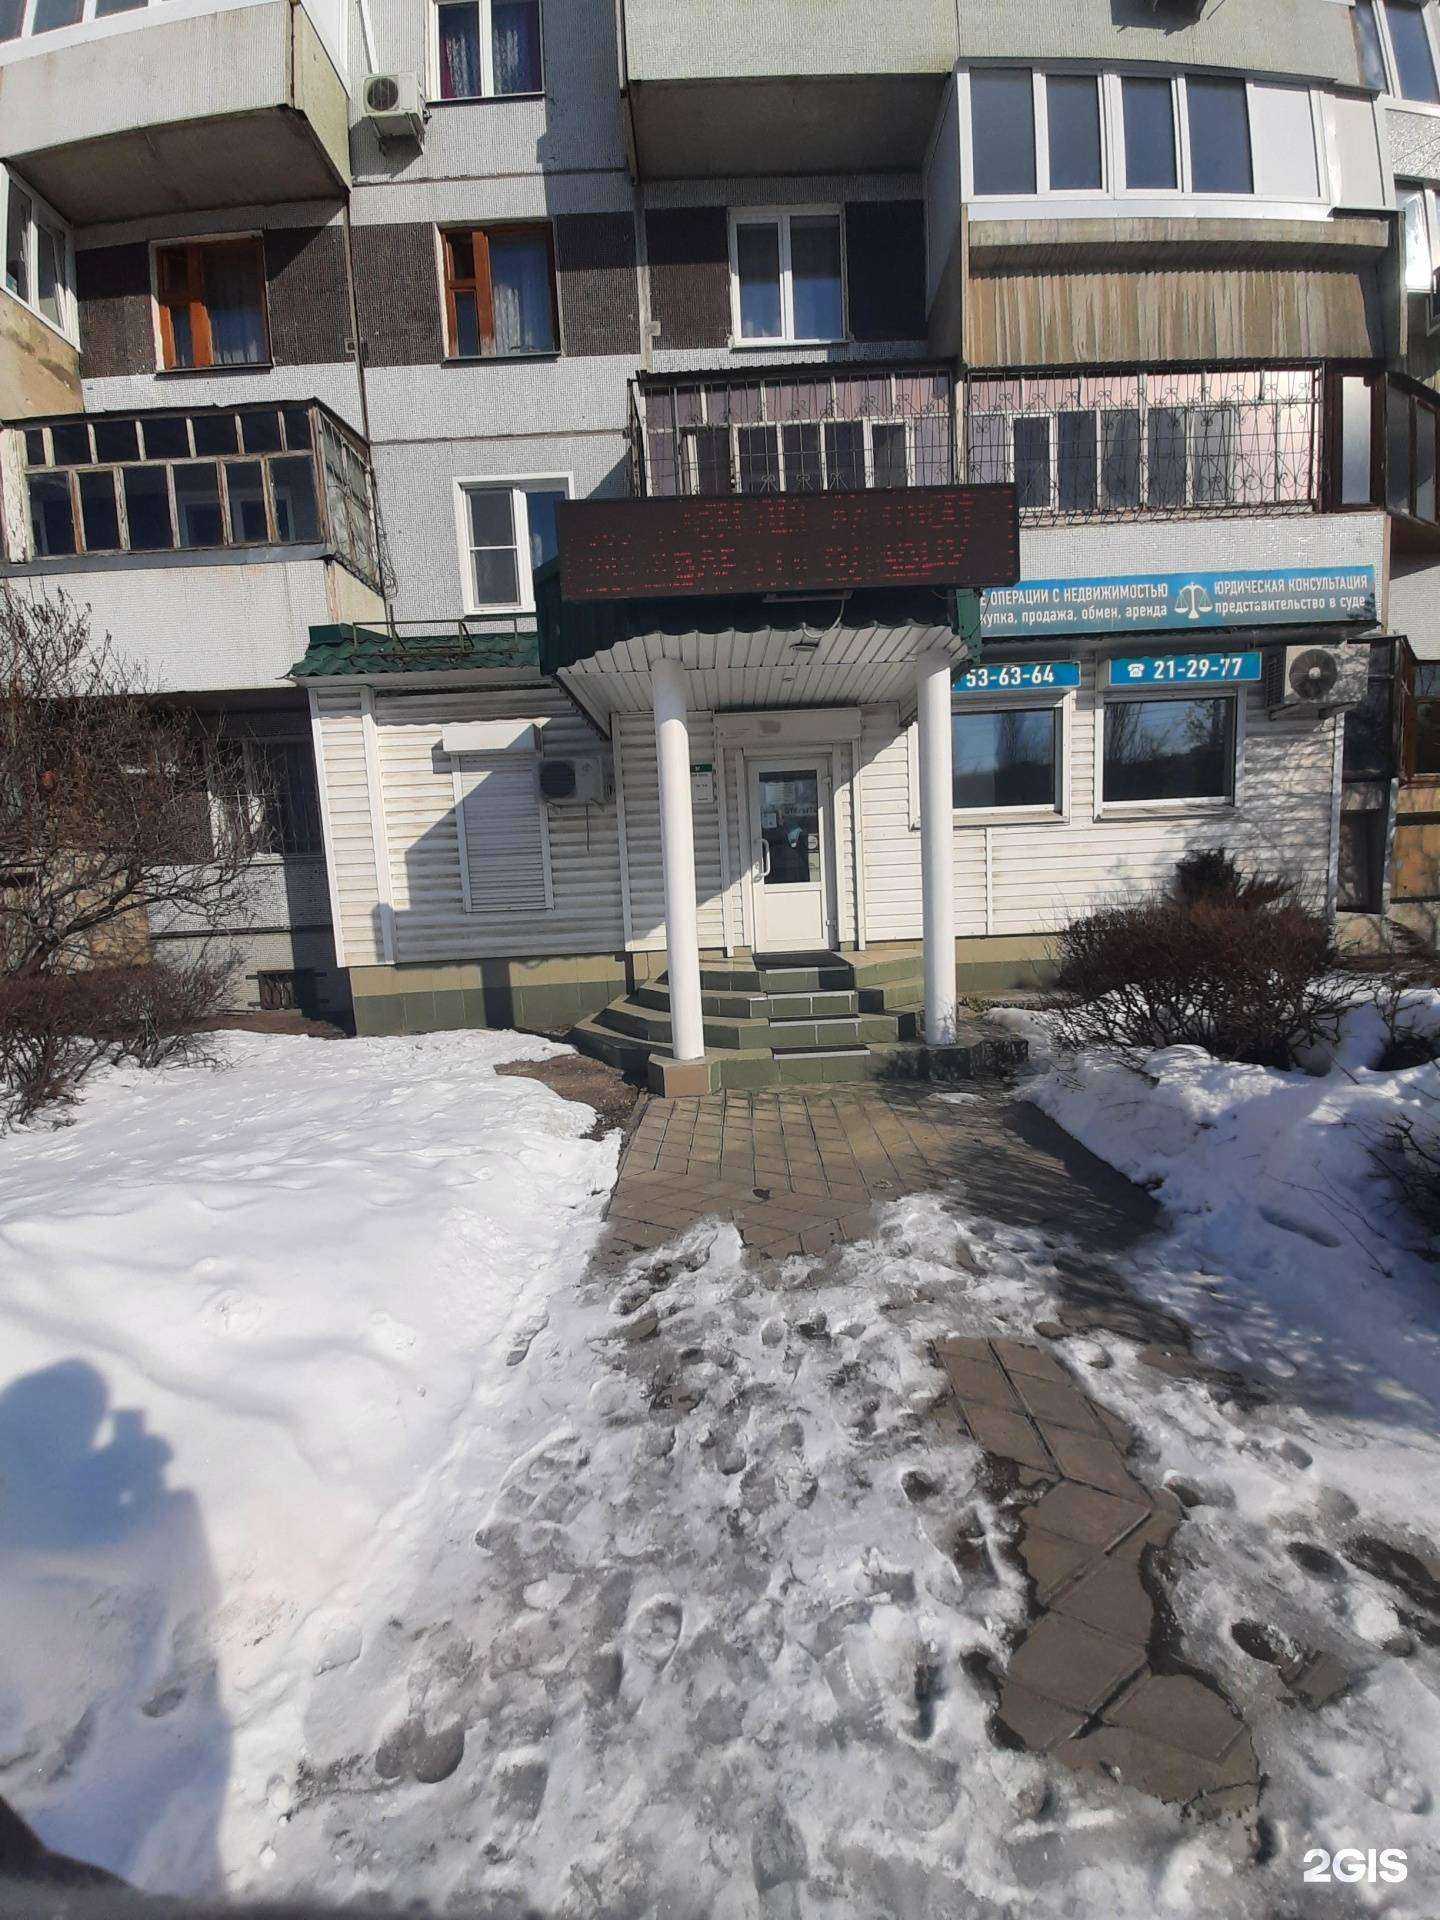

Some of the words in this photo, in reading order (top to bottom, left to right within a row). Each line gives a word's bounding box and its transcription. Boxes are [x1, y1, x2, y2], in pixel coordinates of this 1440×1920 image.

[1288, 574, 1368, 592] КОНСУЛЬТАЦИЯ
[990, 588, 1049, 606] ОПЕРАЦИИ
[1052, 587, 1060, 602] С
[1064, 583, 1168, 602] НЕДВИЖИМОСТЬЮ
[1125, 603, 1167, 620] аренда
[1215, 598, 1325, 615] представительство
[1329, 598, 1337, 608] в
[1340, 596, 1366, 613] суде
[966, 665, 1054, 687] 53-63-64
[1154, 658, 1242, 679] 21-29-77
